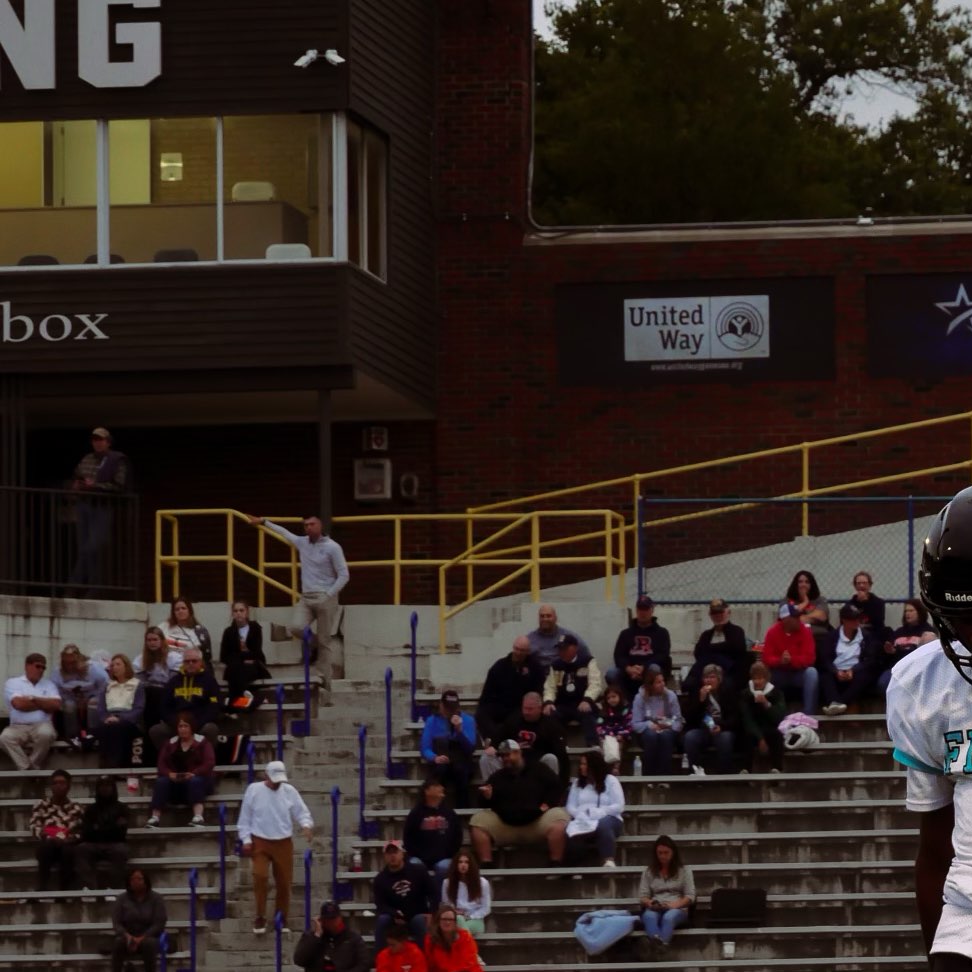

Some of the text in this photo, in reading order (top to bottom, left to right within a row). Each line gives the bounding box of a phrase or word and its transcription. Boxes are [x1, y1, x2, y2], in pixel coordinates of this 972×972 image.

[0, 301, 109, 343] box
[629, 304, 704, 327] United
[658, 329, 704, 355] Way
